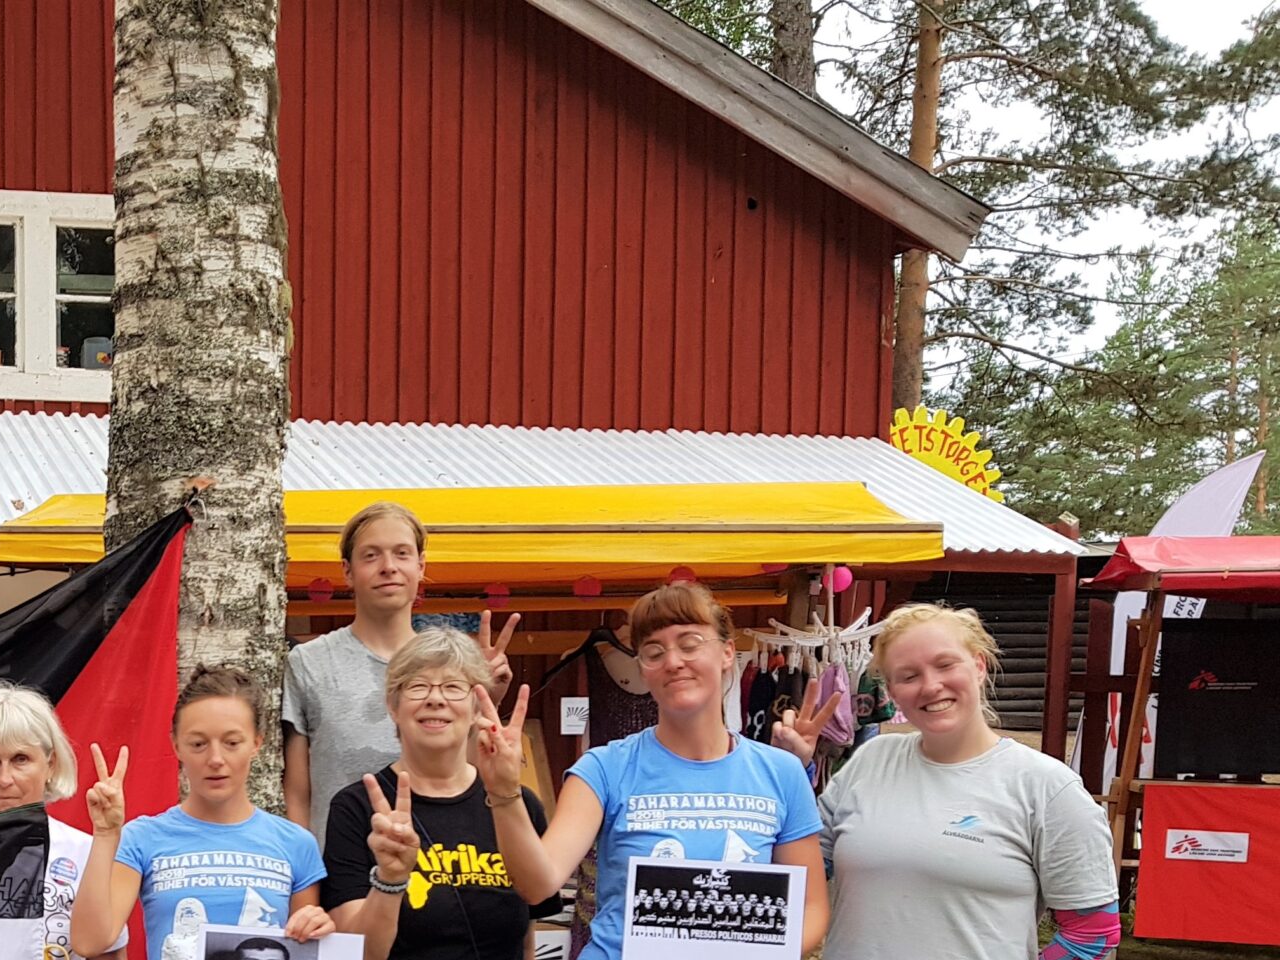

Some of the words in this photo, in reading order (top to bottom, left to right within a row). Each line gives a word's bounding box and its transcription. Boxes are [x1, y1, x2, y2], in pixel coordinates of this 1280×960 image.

[627, 795, 691, 812] SAHARA
[693, 795, 778, 814] MARATHON
[626, 820, 669, 833] FRIHET
[670, 817, 697, 831] FÖR
[152, 853, 211, 872] SAHARA
[416, 843, 507, 875] Afrika
[153, 878, 192, 893] FRIHET
[192, 874, 216, 887] FÖR
[429, 872, 513, 887] GRUPPERN
